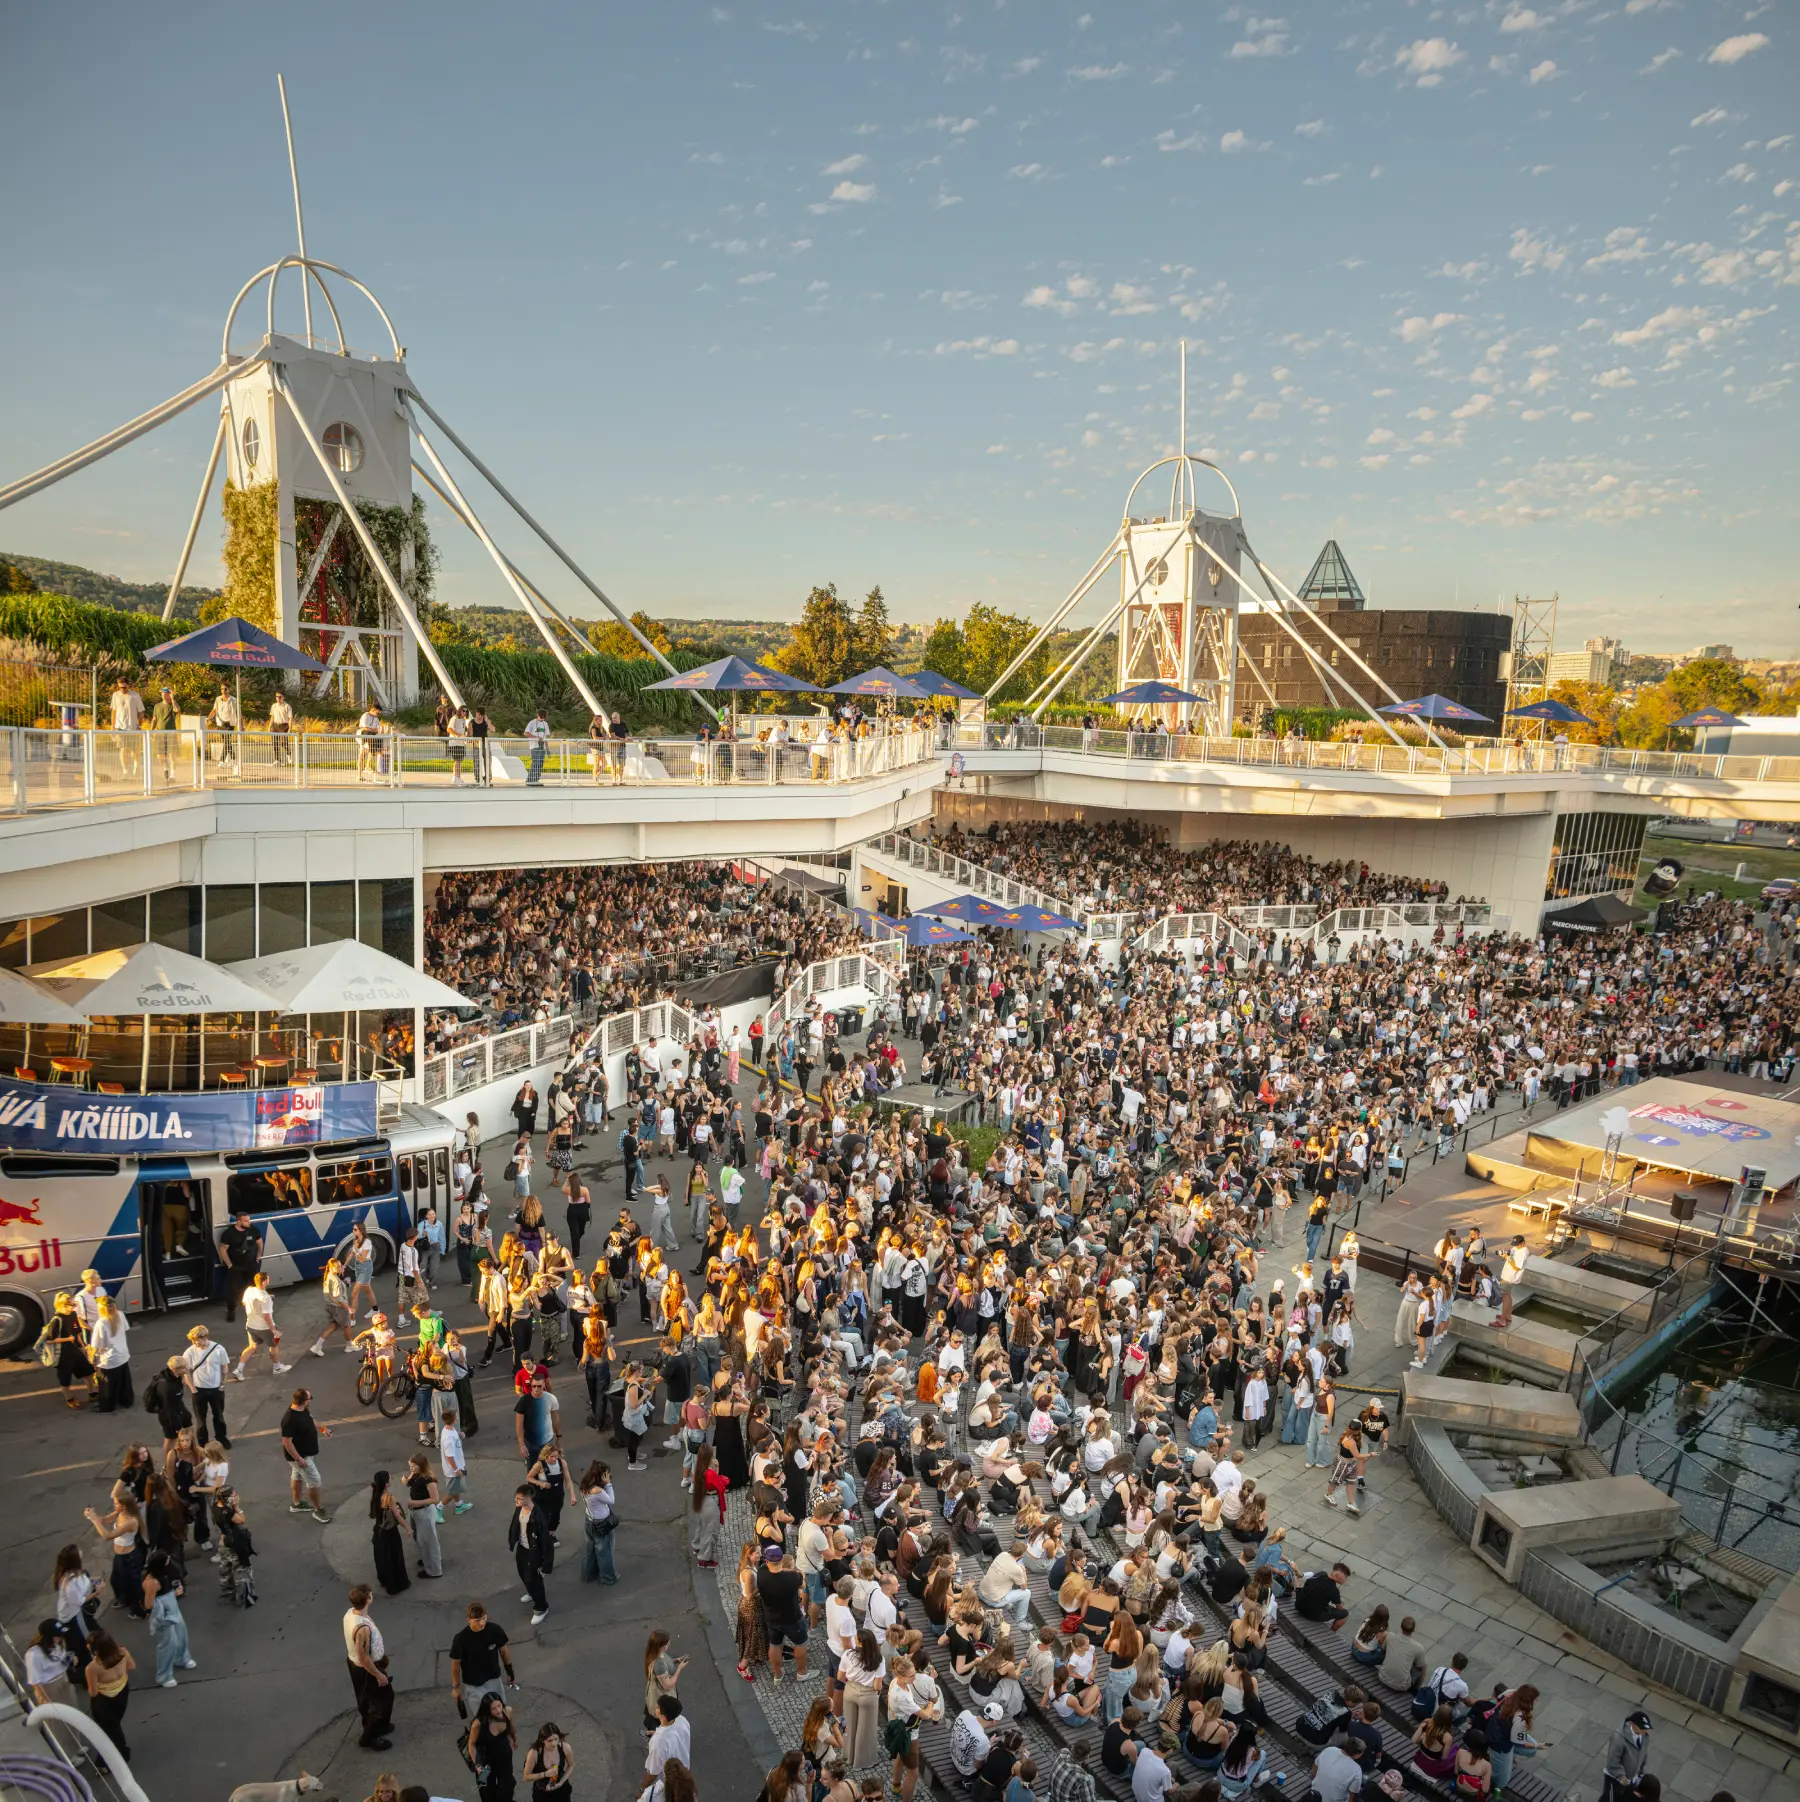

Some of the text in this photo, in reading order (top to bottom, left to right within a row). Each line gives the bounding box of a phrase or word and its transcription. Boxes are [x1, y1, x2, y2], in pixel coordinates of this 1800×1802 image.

[210, 651, 276, 663] Red Bull
[1551, 920, 1597, 933] MERCHANDISE
[136, 994, 213, 1007] Red Bull
[342, 987, 410, 1002] Red Bull
[257, 1091, 321, 1115] Red Bull
[56, 1104, 193, 1140] KŘÍÍÍDLA.
[0, 1238, 61, 1276] Bull
[1329, 1279, 1341, 1290] 17
